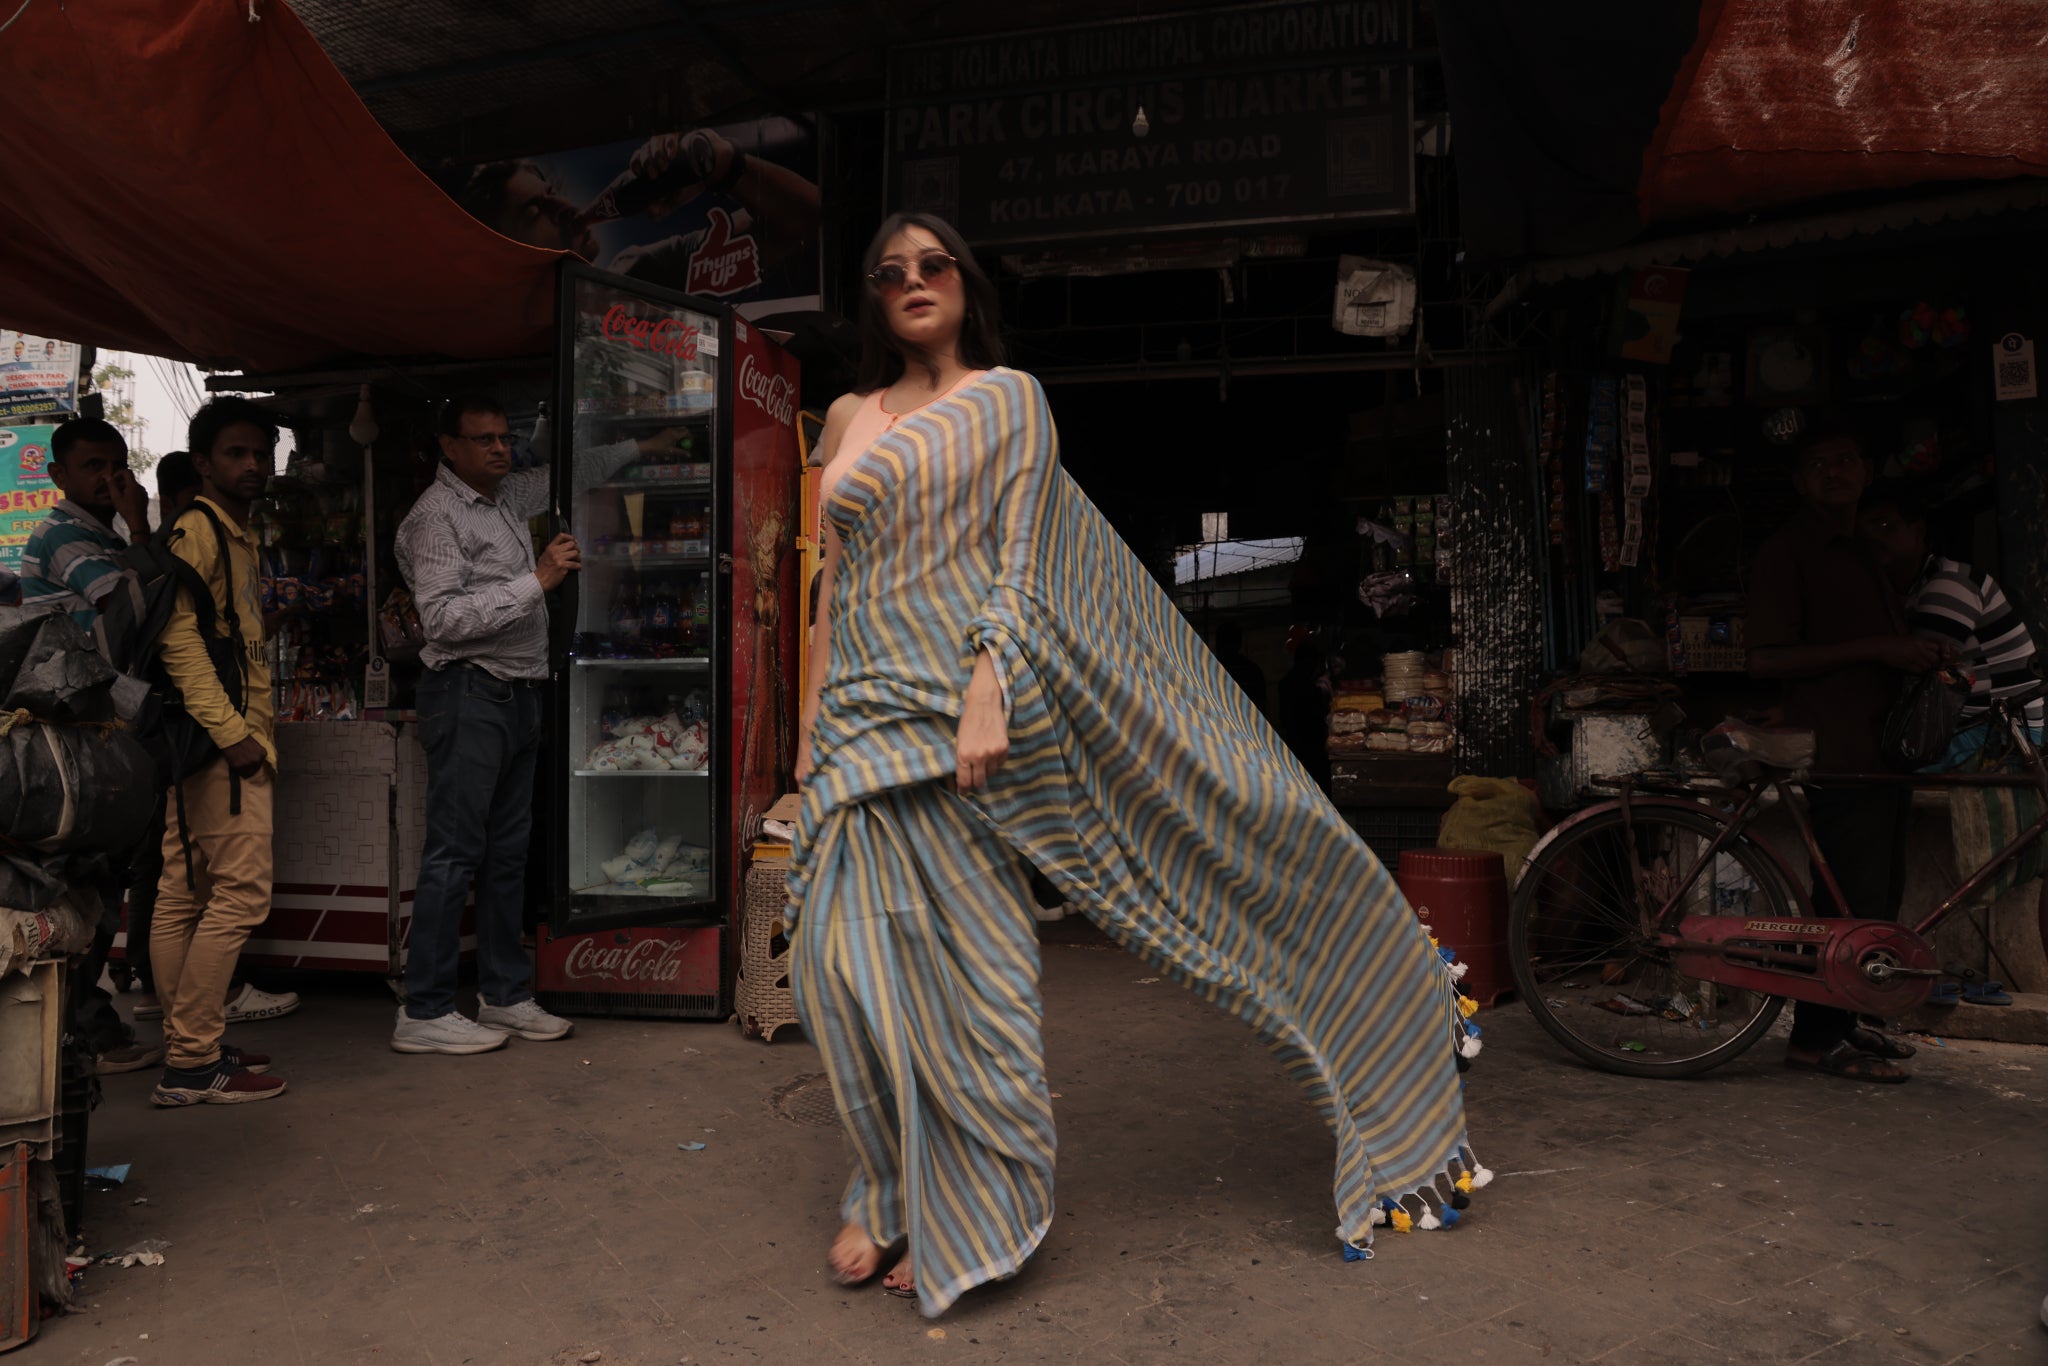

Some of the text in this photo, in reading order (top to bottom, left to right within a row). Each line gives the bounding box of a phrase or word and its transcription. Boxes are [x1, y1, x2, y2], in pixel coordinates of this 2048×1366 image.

[952, 38, 1060, 89] KOLKATA
[1068, 21, 1203, 76] MUNICIPAL
[1213, 2, 1399, 57] CORPORATION
[896, 64, 1399, 150] PARK CIRCUS MARKET
[998, 133, 1282, 184] 47, KARAYA ROAD
[989, 189, 1135, 224] KOLKATA
[1166, 179, 1222, 208] 700
[1233, 174, 1292, 202] 017
[692, 245, 752, 281] Thums
[565, 937, 689, 981] Coca-Cola
[244, 1005, 282, 1019] crocs
